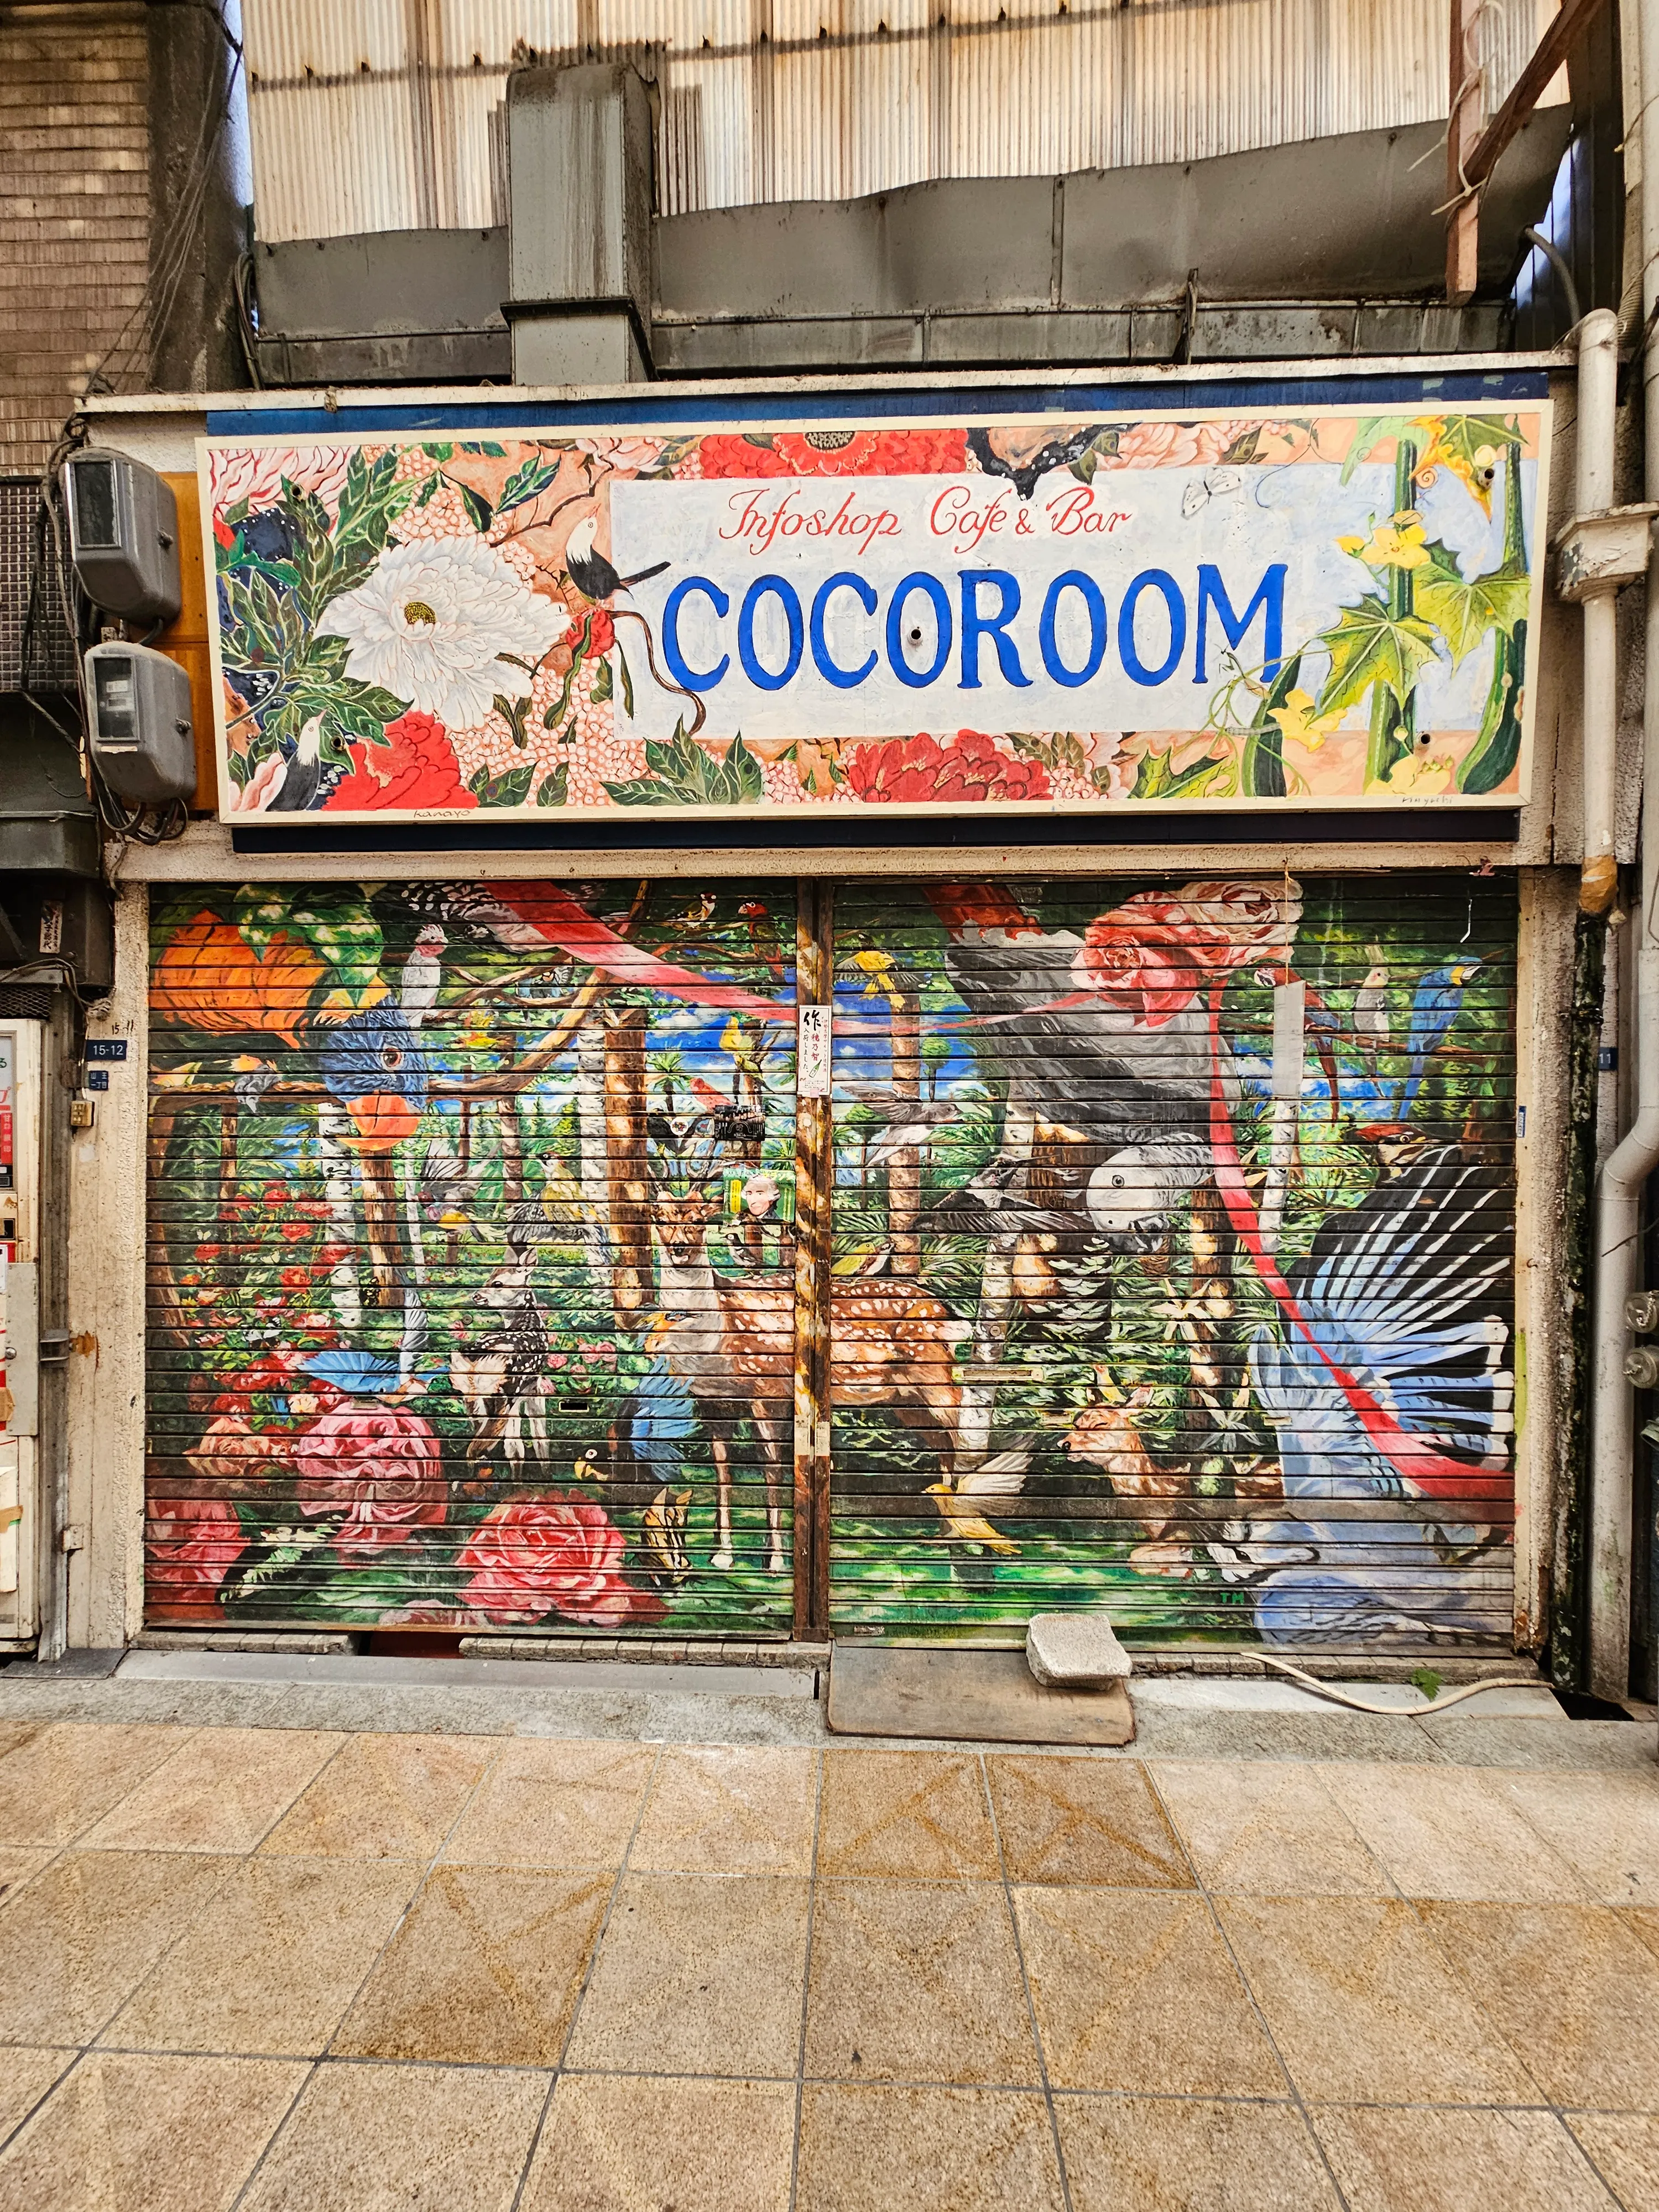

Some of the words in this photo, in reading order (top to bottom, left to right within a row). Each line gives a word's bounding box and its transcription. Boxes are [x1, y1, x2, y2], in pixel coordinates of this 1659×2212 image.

[718, 488, 901, 556] Infoshop
[1015, 508, 1034, 536] &
[1044, 486, 1131, 536] Bar
[663, 564, 1288, 692] COCOROOM
[804, 1010, 821, 1031] 作
[93, 1045, 124, 1056] 15-12
[90, 1081, 107, 1089] 一丁目
[1220, 1592, 1245, 1605] TM
